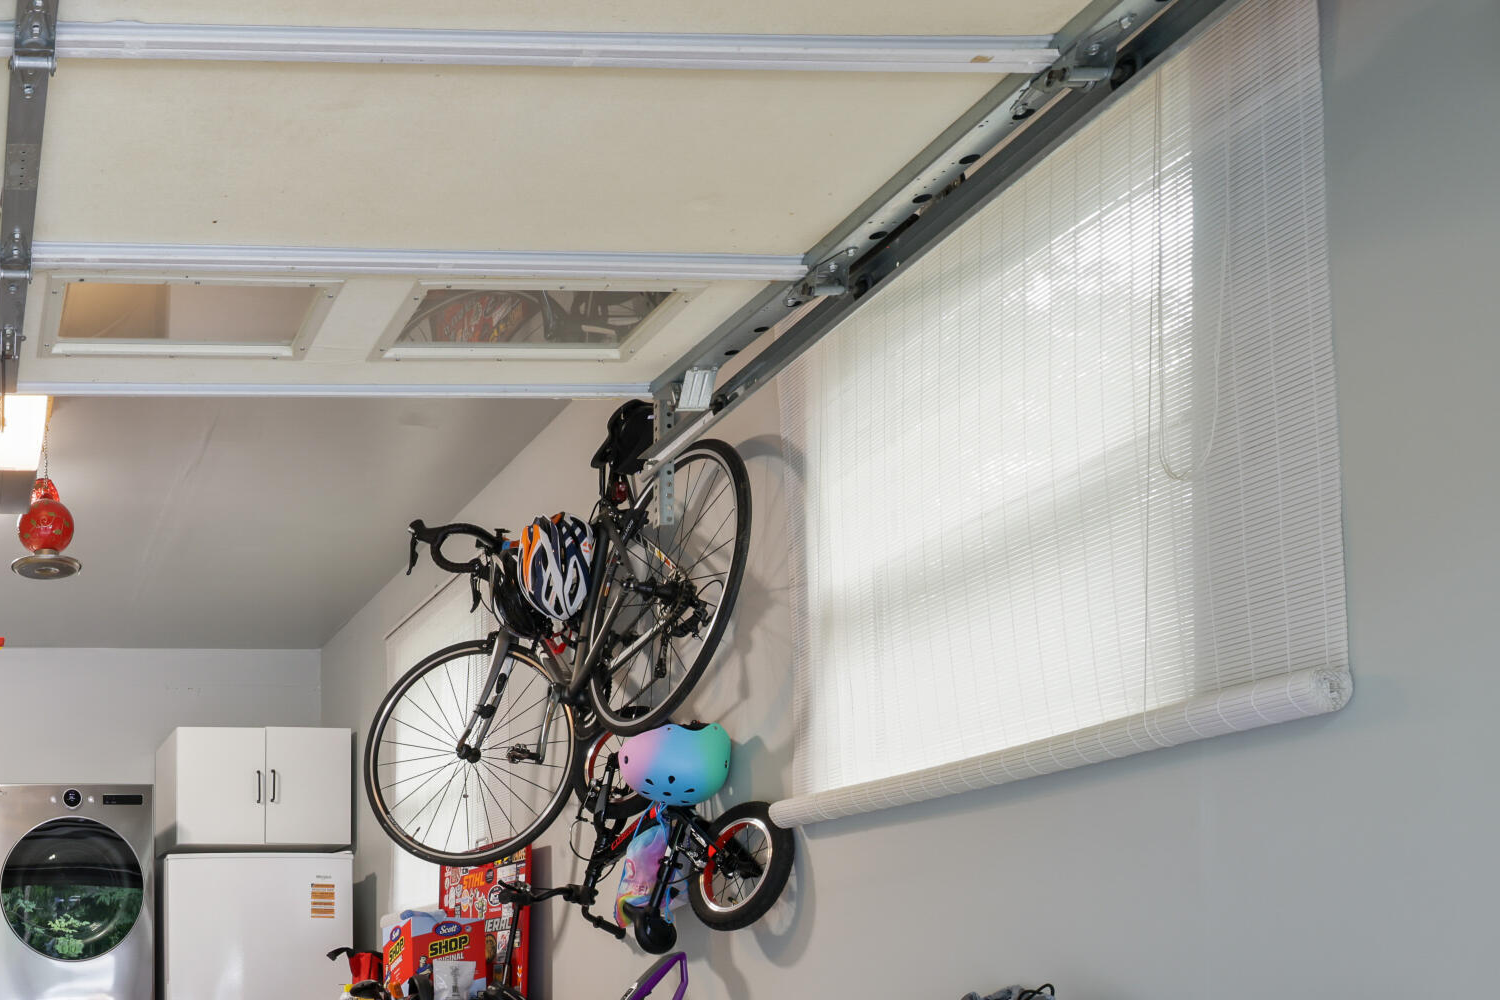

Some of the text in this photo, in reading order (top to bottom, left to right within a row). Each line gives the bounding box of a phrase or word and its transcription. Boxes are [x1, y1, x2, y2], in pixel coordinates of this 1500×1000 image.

[463, 872, 485, 890] STIHL
[440, 924, 458, 935] Scott
[429, 936, 468, 957] SHOP
